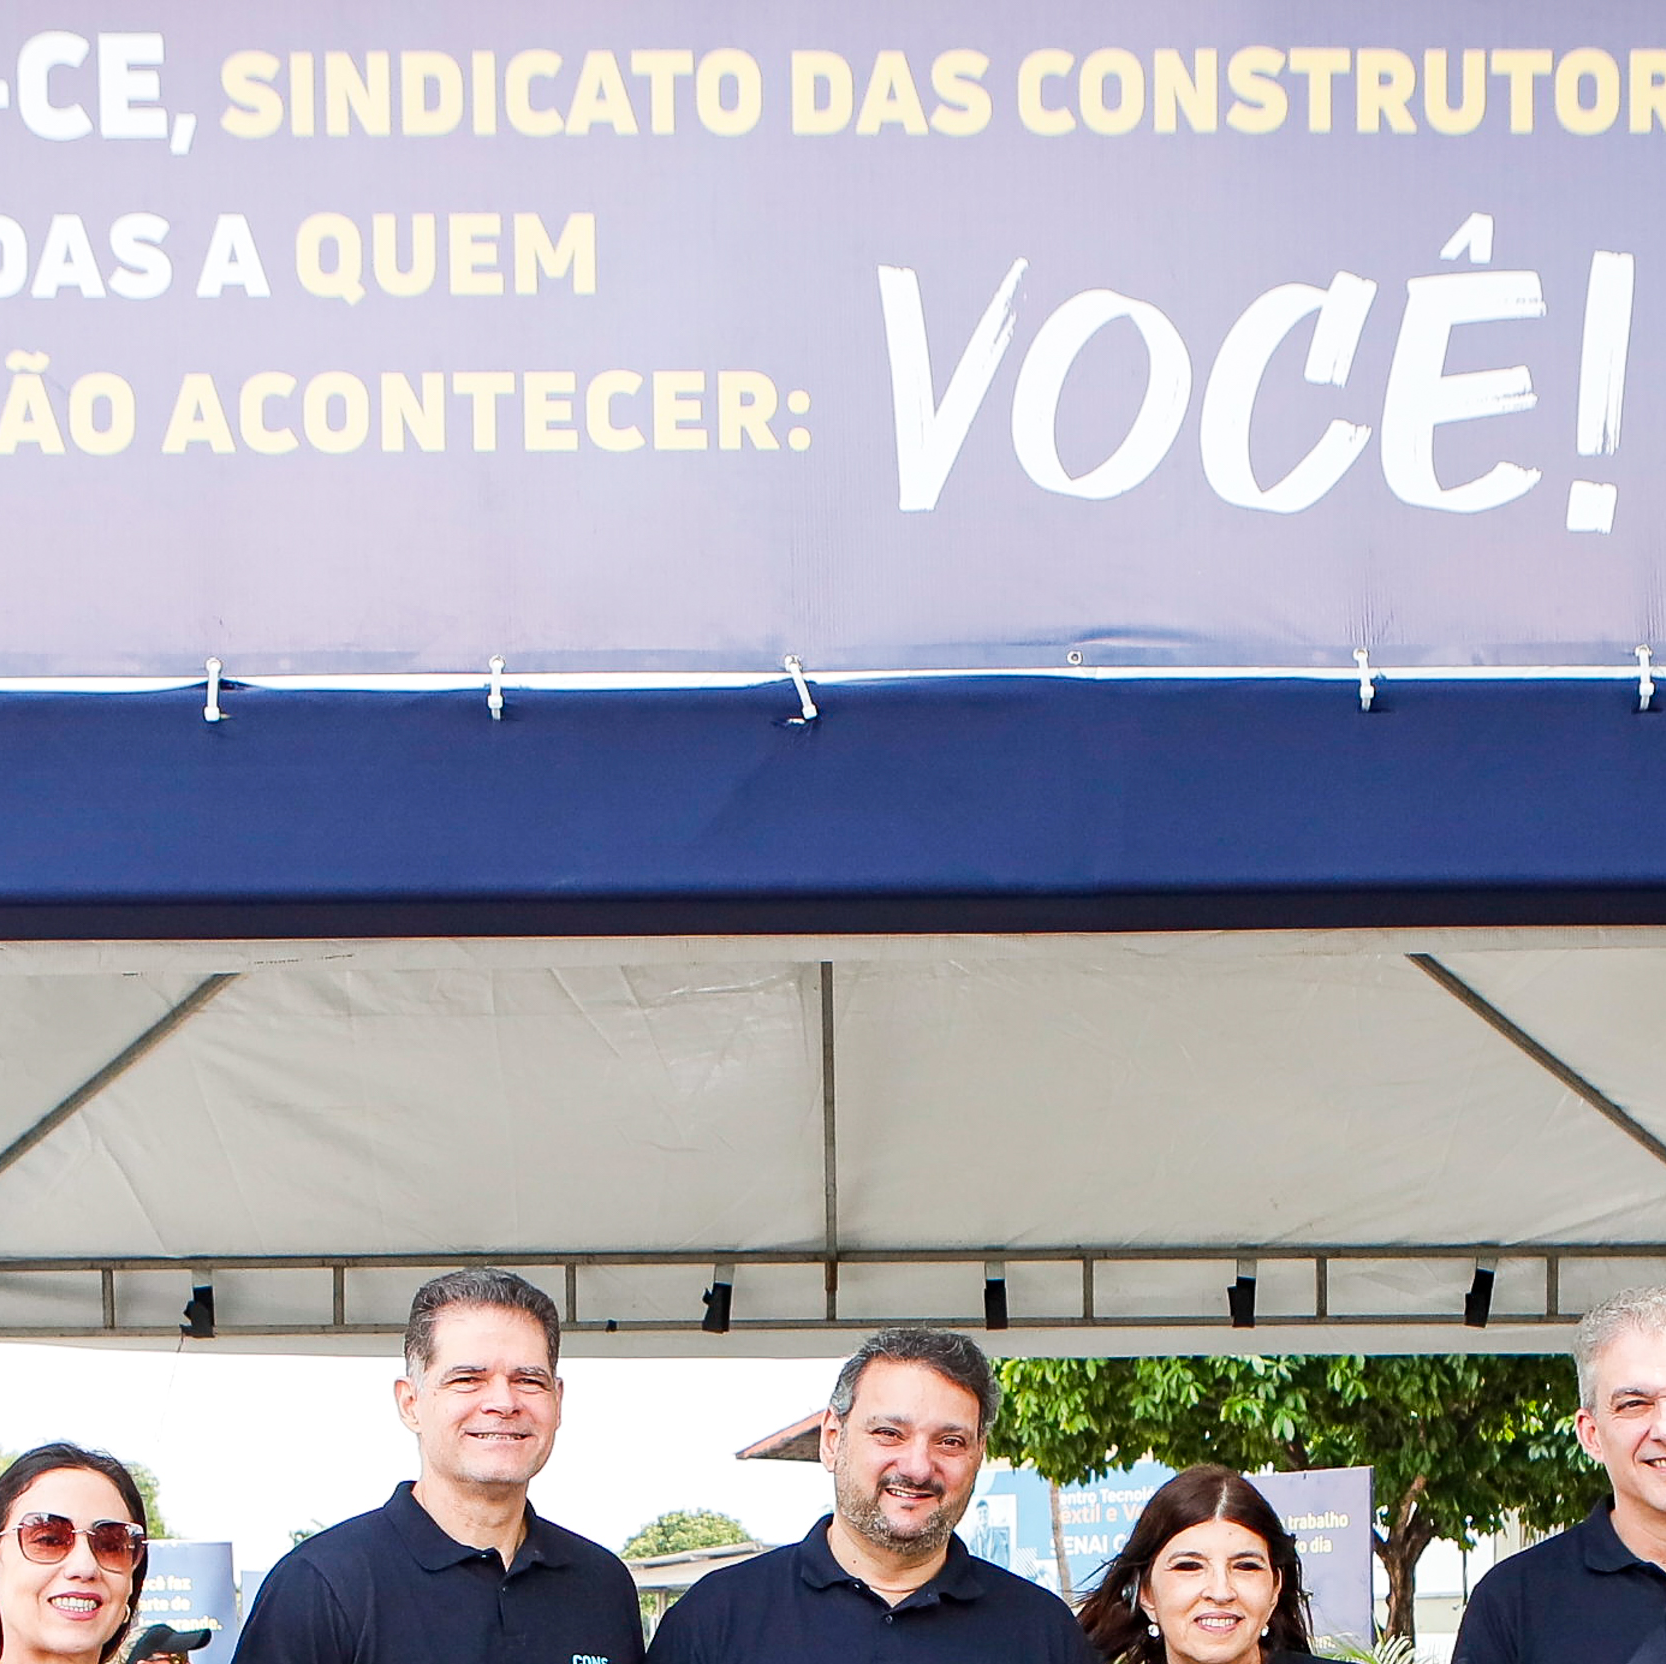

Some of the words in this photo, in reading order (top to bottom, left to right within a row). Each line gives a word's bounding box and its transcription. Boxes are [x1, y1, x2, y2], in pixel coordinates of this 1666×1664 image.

[220, 48, 763, 138] SINDICATO
[791, 48, 993, 137] DAS
[197, 212, 271, 299] A
[294, 211, 598, 305] QUEM
[877, 211, 1637, 535] VOCÊ!
[162, 369, 814, 455] ACONTECER:
[1059, 1492, 1097, 1506] entro
[1099, 1485, 1157, 1504] Tecnoló
[1060, 1503, 1101, 1525] êxtil
[1106, 1507, 1118, 1523] e
[1287, 1511, 1350, 1530] trabalho
[1309, 1535, 1333, 1554] dia
[141, 1574, 166, 1592] ocê
[138, 1597, 169, 1612] arte
[171, 1595, 191, 1612] de
